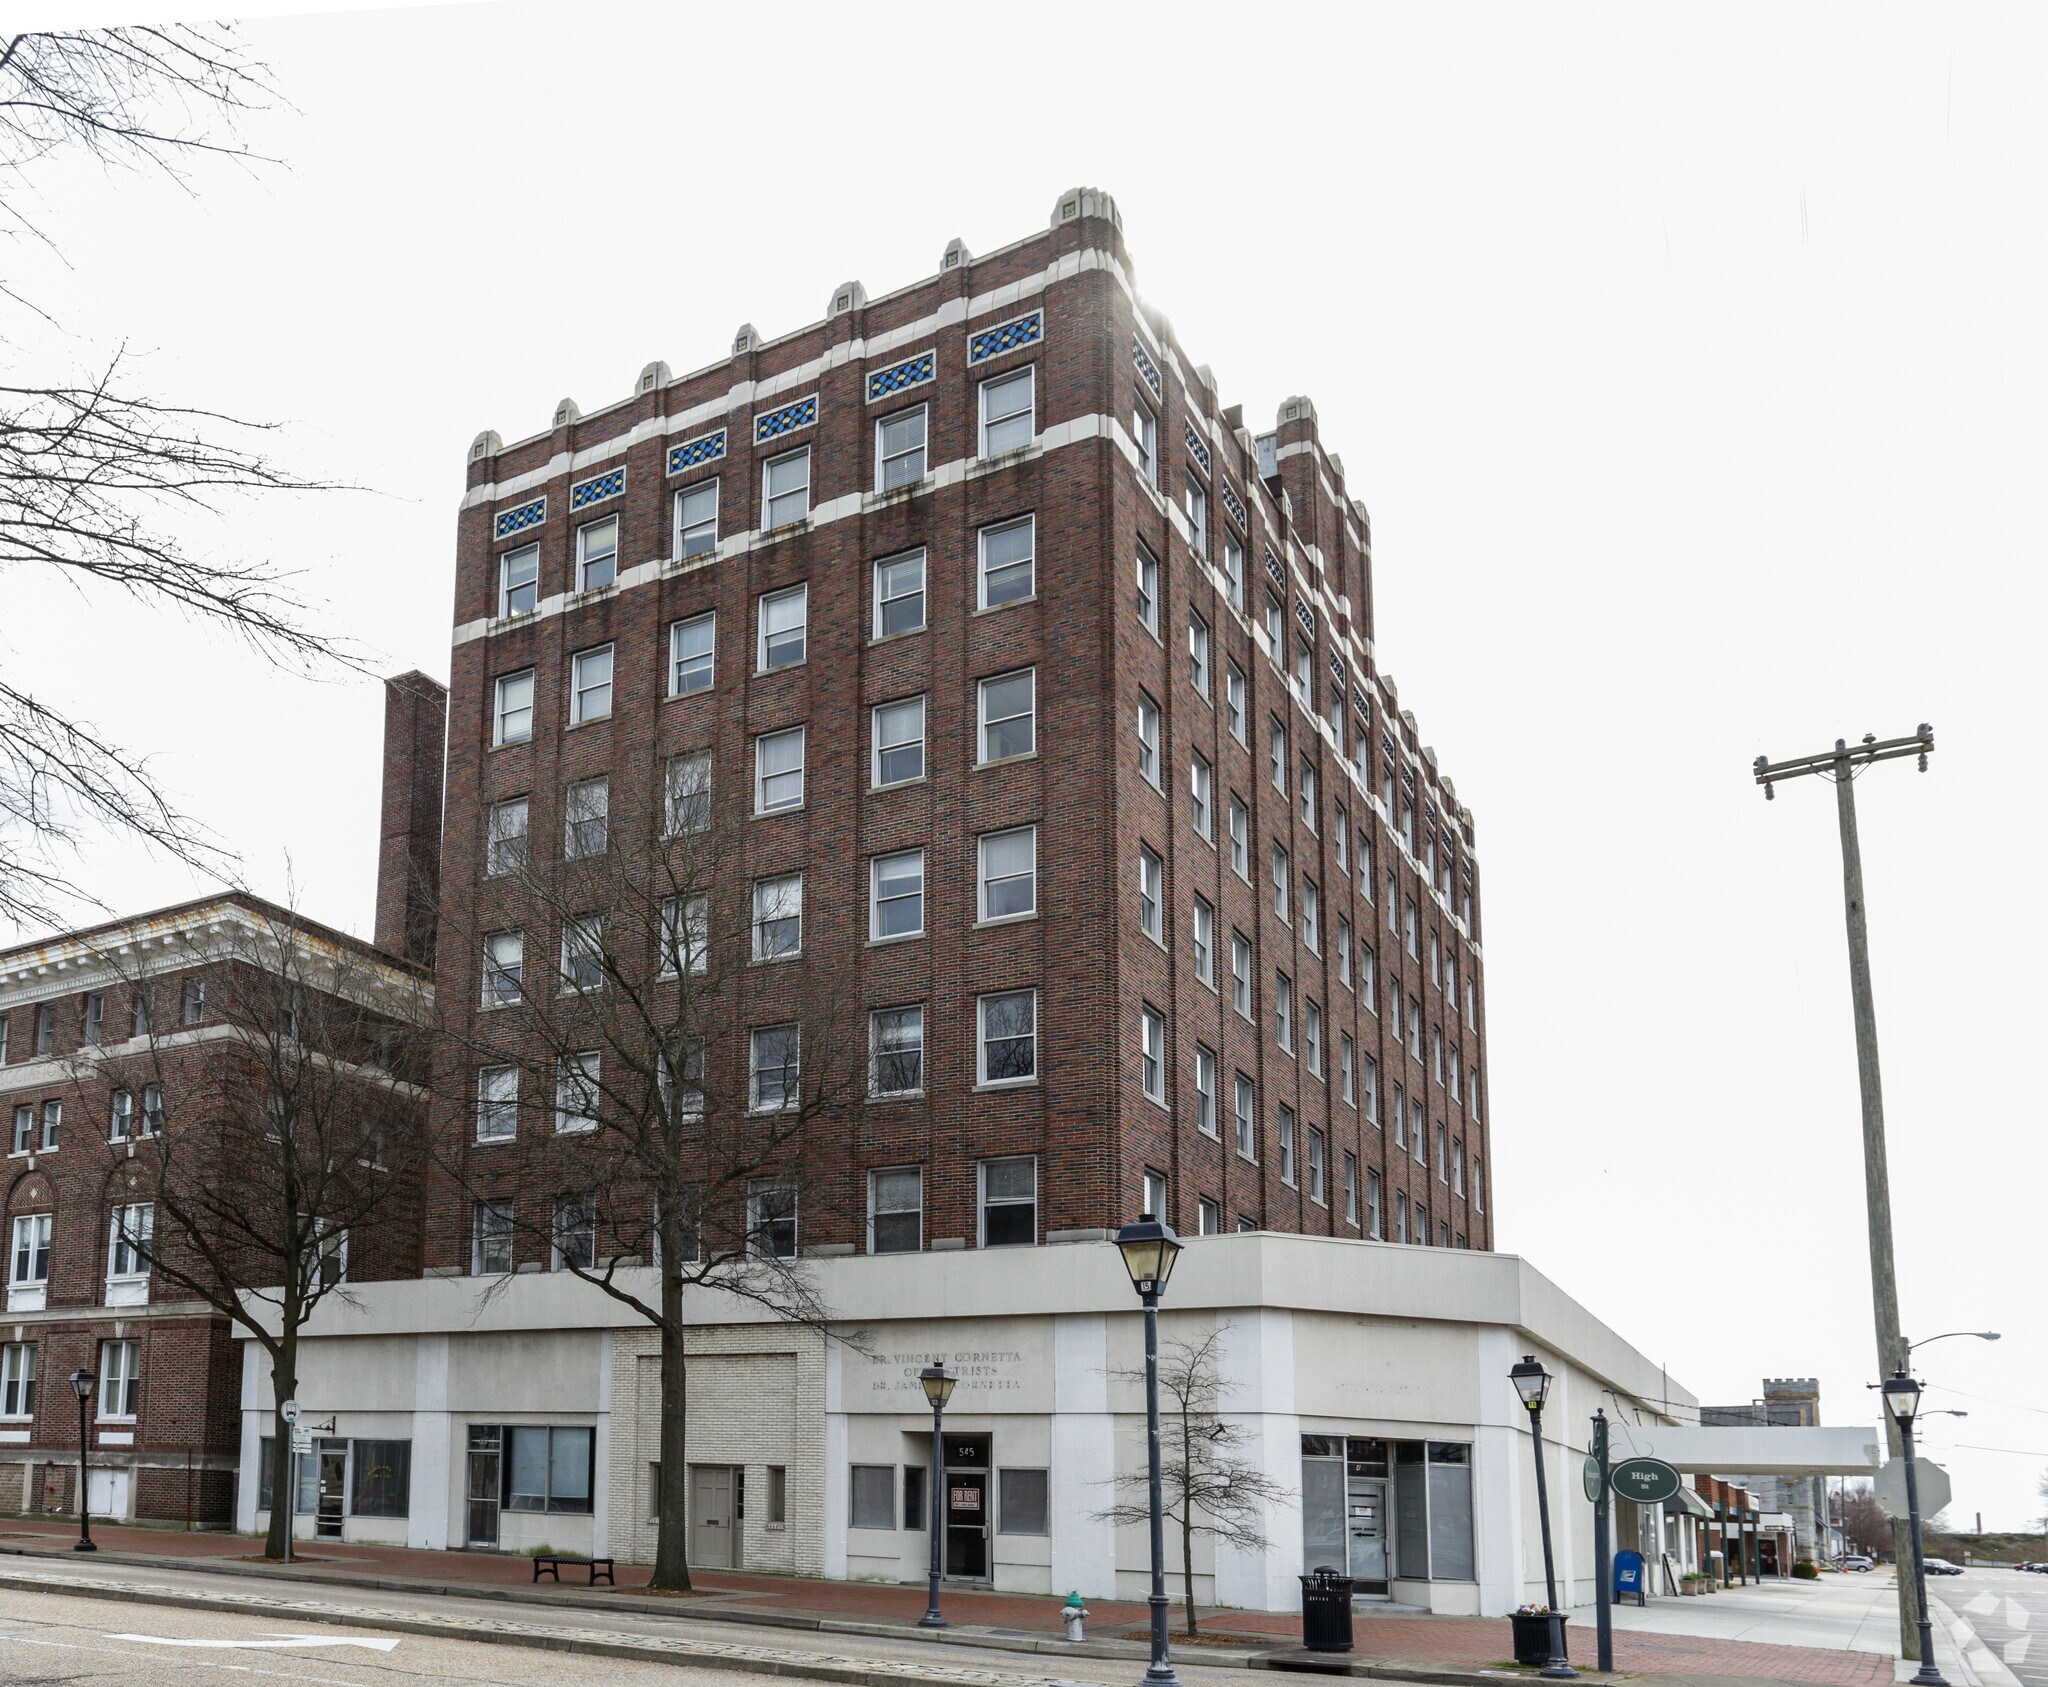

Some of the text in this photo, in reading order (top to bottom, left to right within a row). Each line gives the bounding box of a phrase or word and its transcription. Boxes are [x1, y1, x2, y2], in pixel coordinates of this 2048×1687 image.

[893, 1353, 948, 1364] VINCENT
[954, 1352, 1021, 1362] CORNETTA
[959, 1447, 975, 1457] 545
[1631, 1472, 1659, 1482] High
[953, 1490, 978, 1502] FOR RENT
